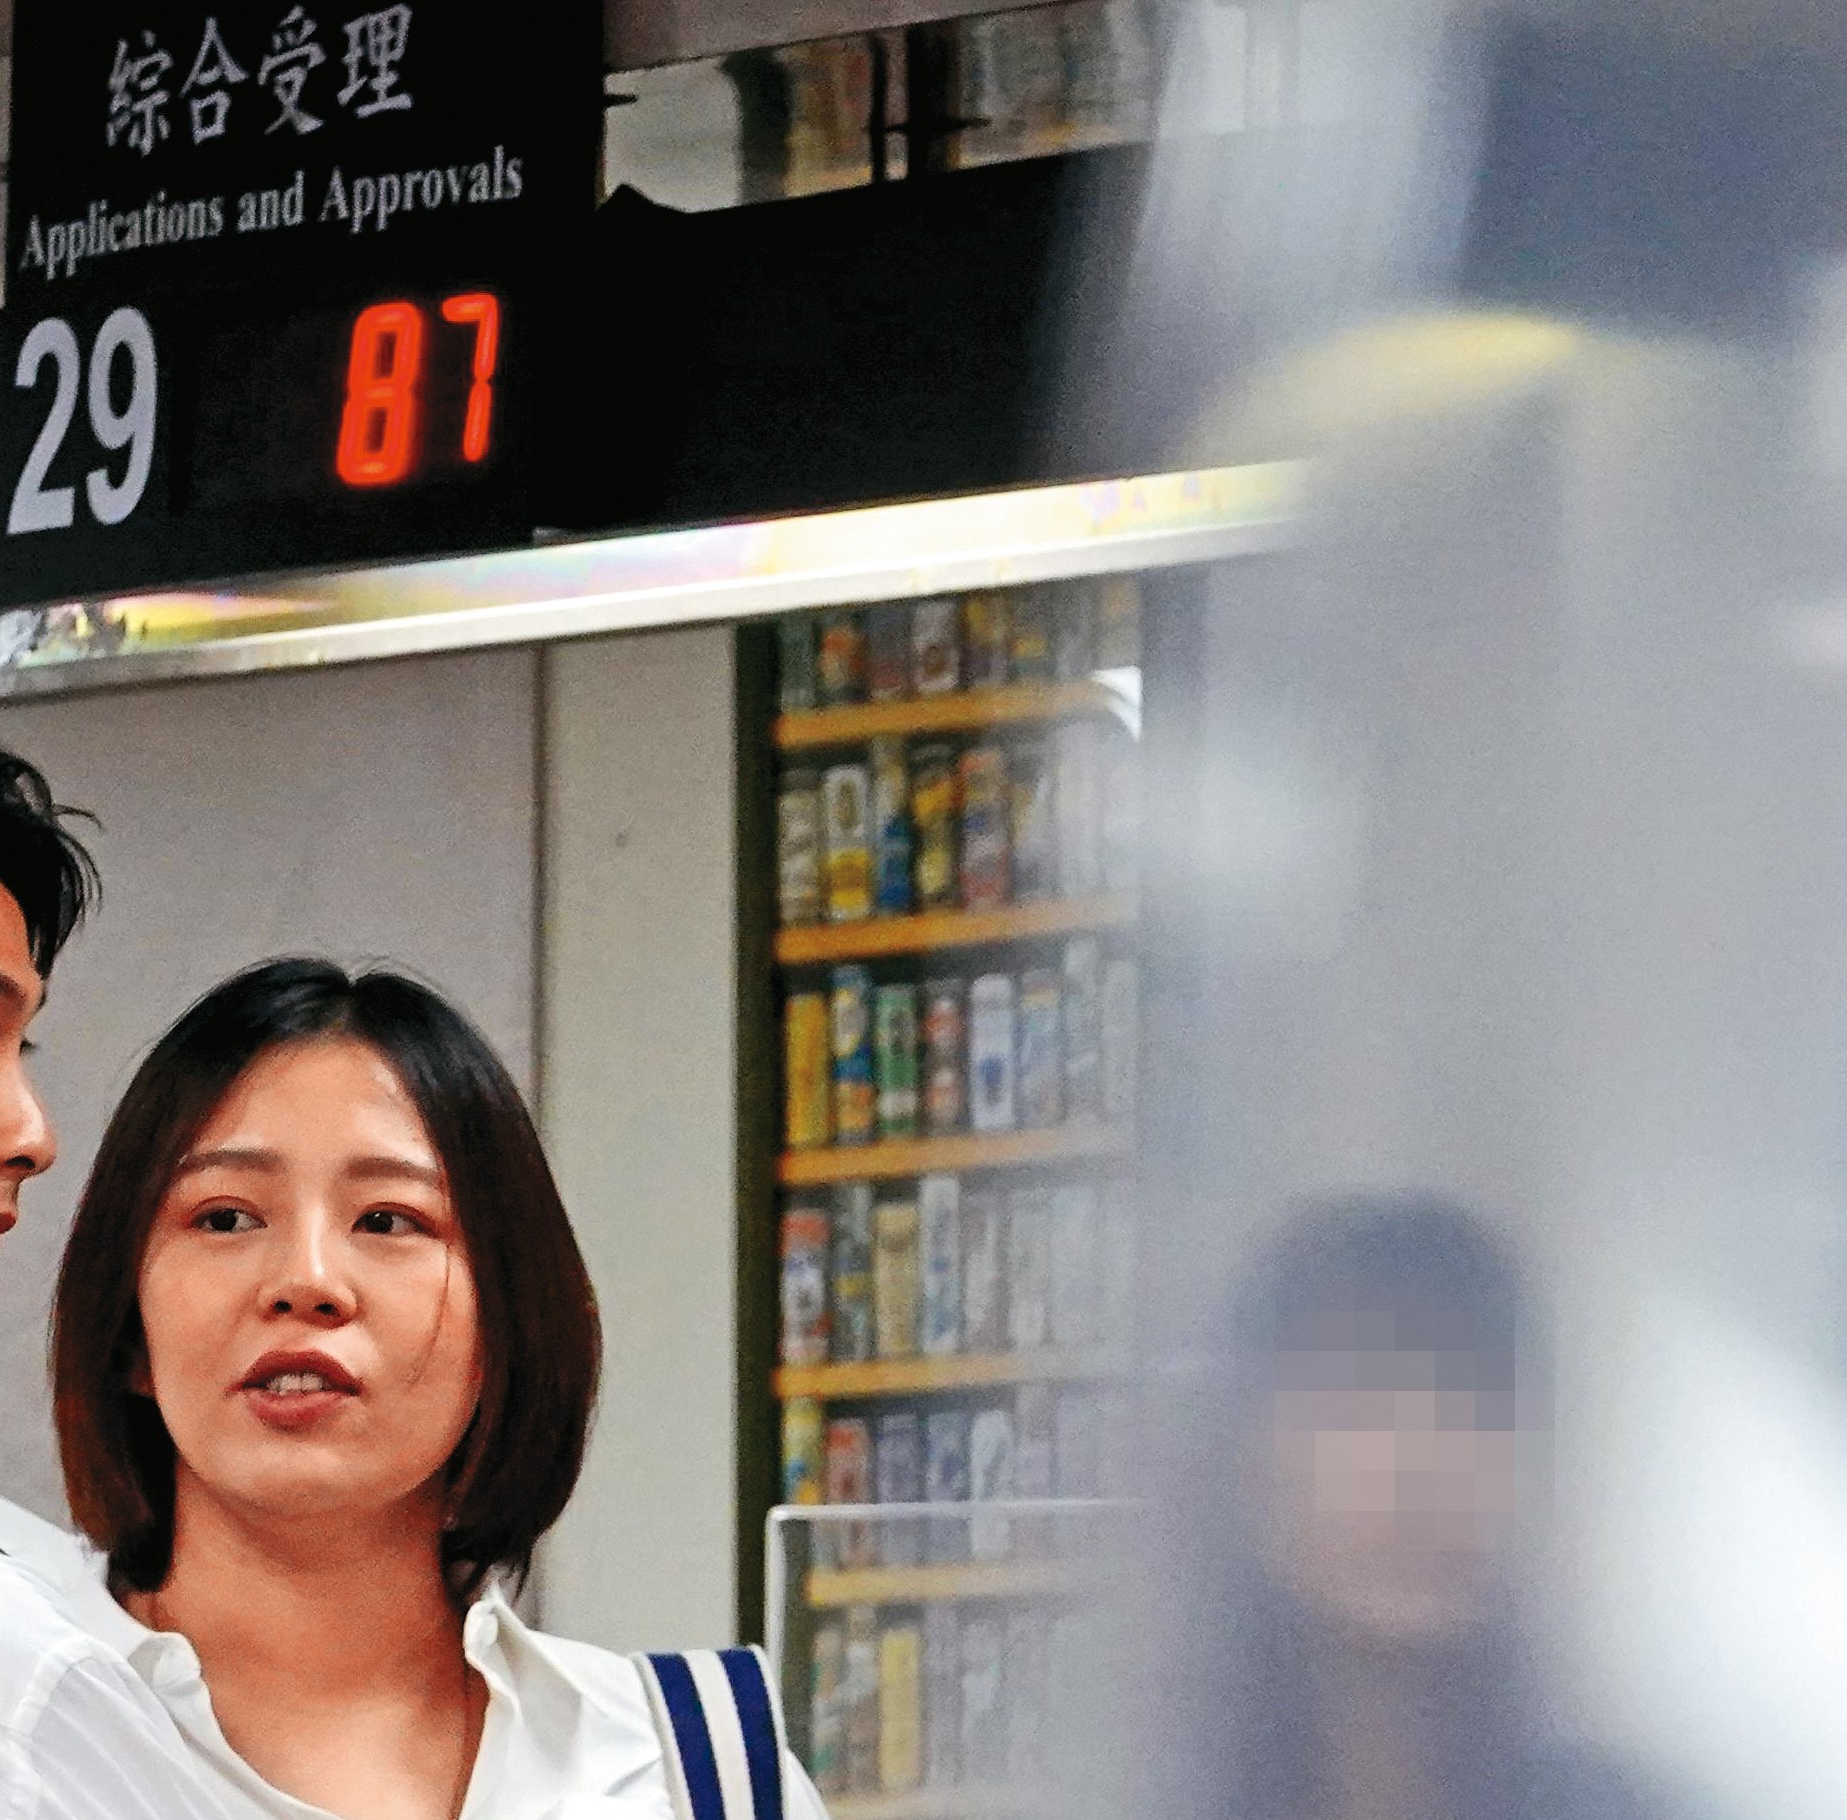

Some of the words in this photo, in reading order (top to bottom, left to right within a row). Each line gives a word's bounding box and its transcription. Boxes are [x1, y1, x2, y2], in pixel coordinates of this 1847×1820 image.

[106, 3, 412, 156] 綜合受理
[19, 191, 224, 280] Applications
[237, 168, 304, 231] and
[321, 145, 524, 233] Approvals
[6, 306, 157, 535] 29
[336, 292, 499, 486] 87
